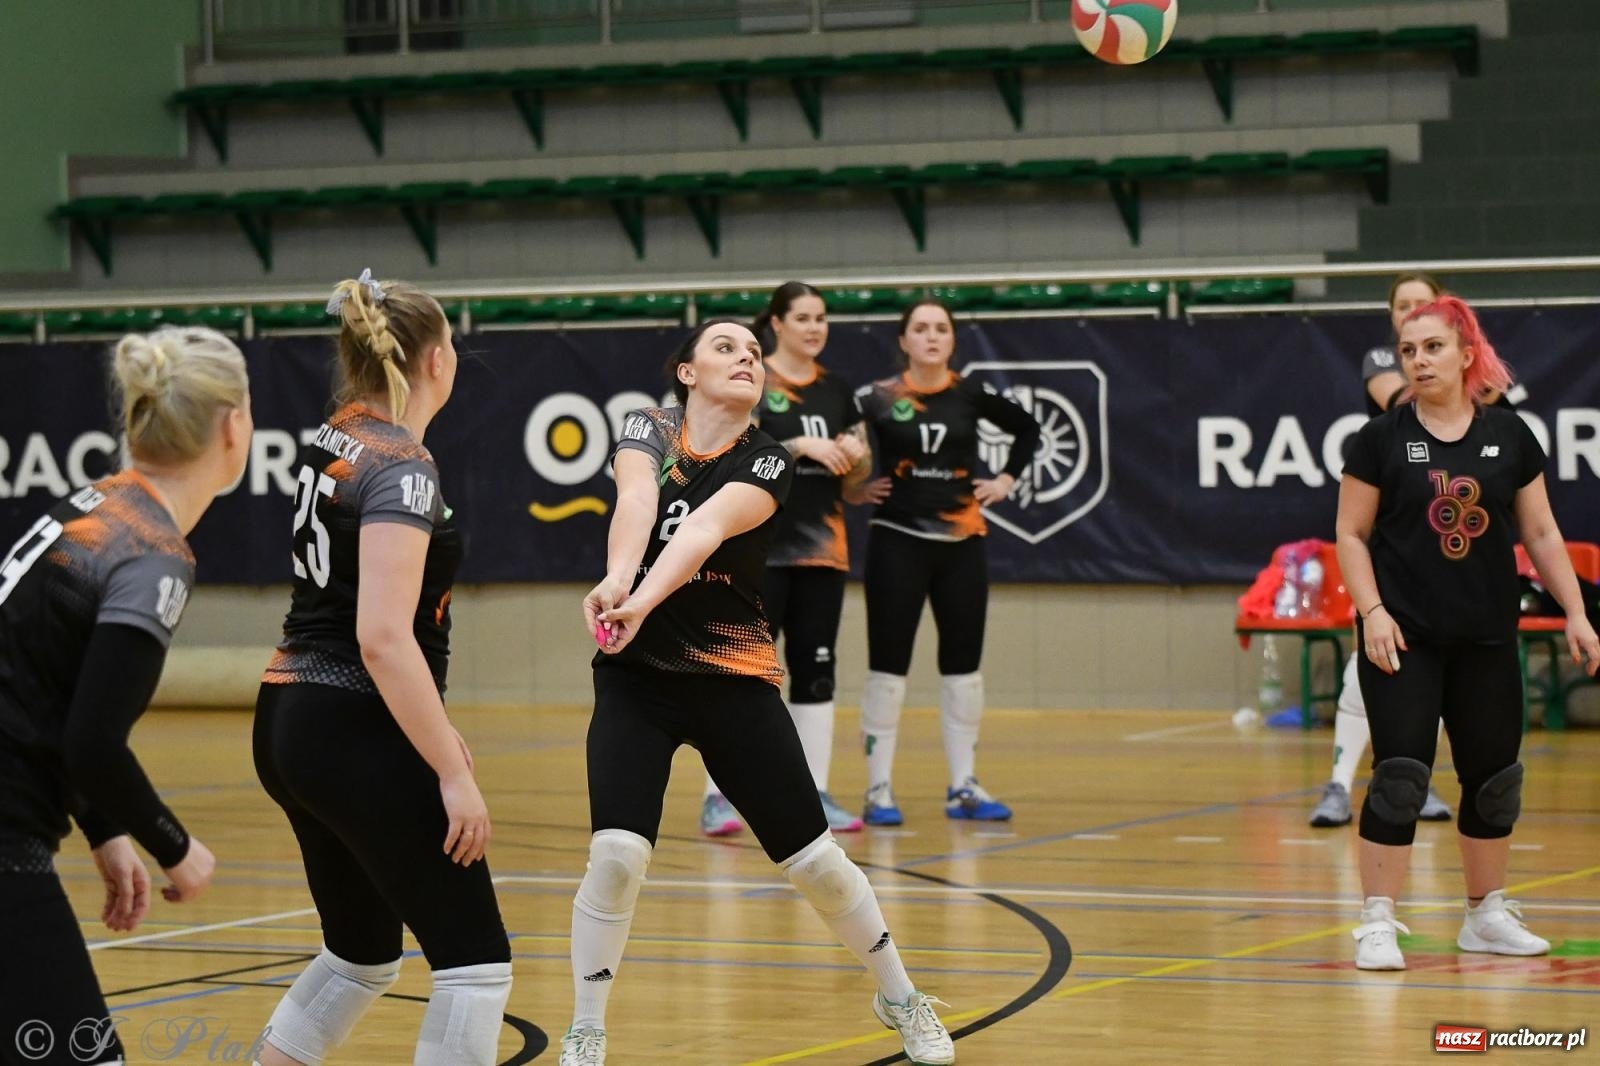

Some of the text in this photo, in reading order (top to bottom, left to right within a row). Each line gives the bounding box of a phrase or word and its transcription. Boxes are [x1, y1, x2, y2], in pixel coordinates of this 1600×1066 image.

[919, 422, 948, 454] 17
[292, 464, 337, 589] 25
[659, 499, 690, 541] 2
